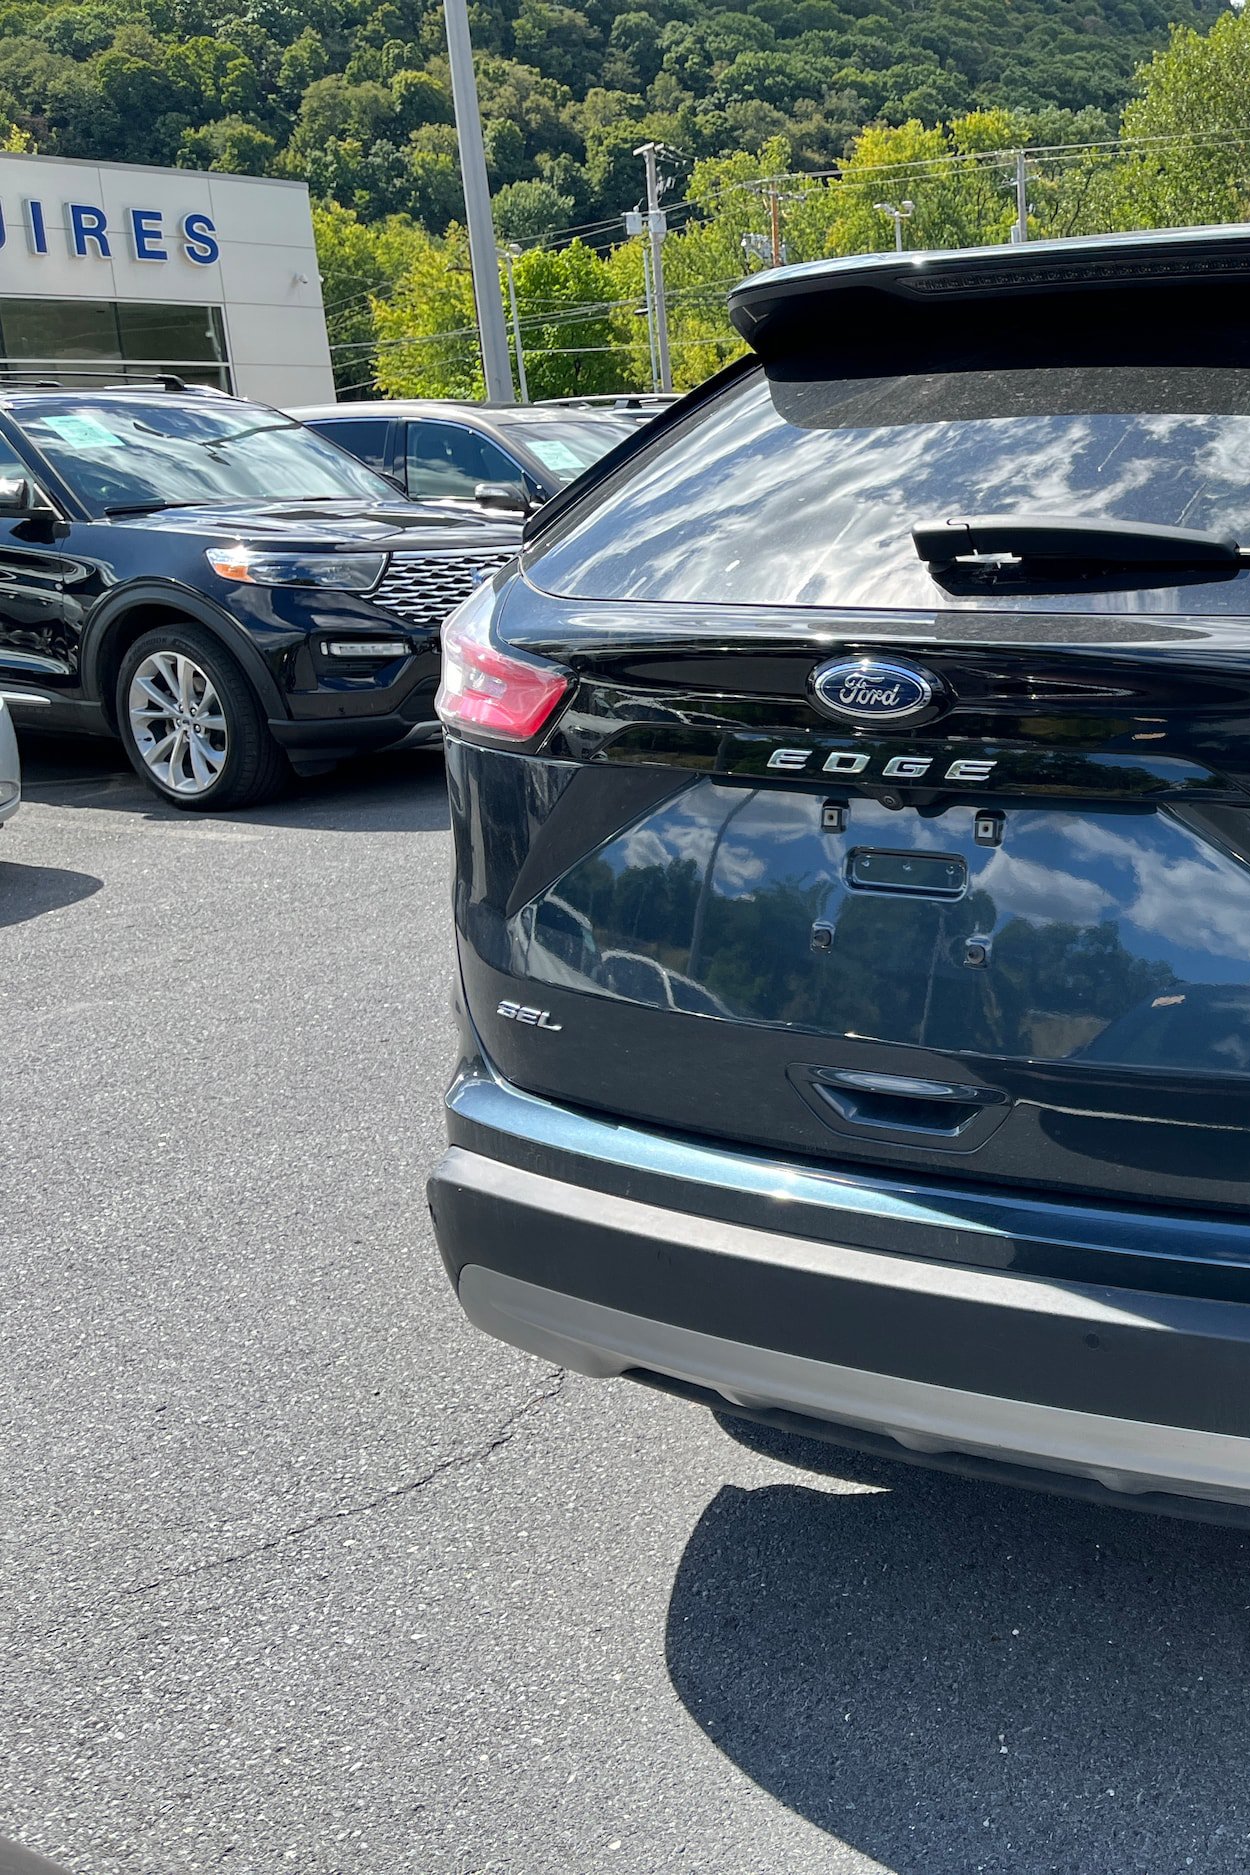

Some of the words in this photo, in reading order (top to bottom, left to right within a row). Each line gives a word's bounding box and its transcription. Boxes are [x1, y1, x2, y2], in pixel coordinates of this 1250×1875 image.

[0, 196, 221, 266] IRES
[839, 672, 900, 707] Ford
[766, 748, 998, 781] EDGE
[496, 1000, 563, 1031] SEL
